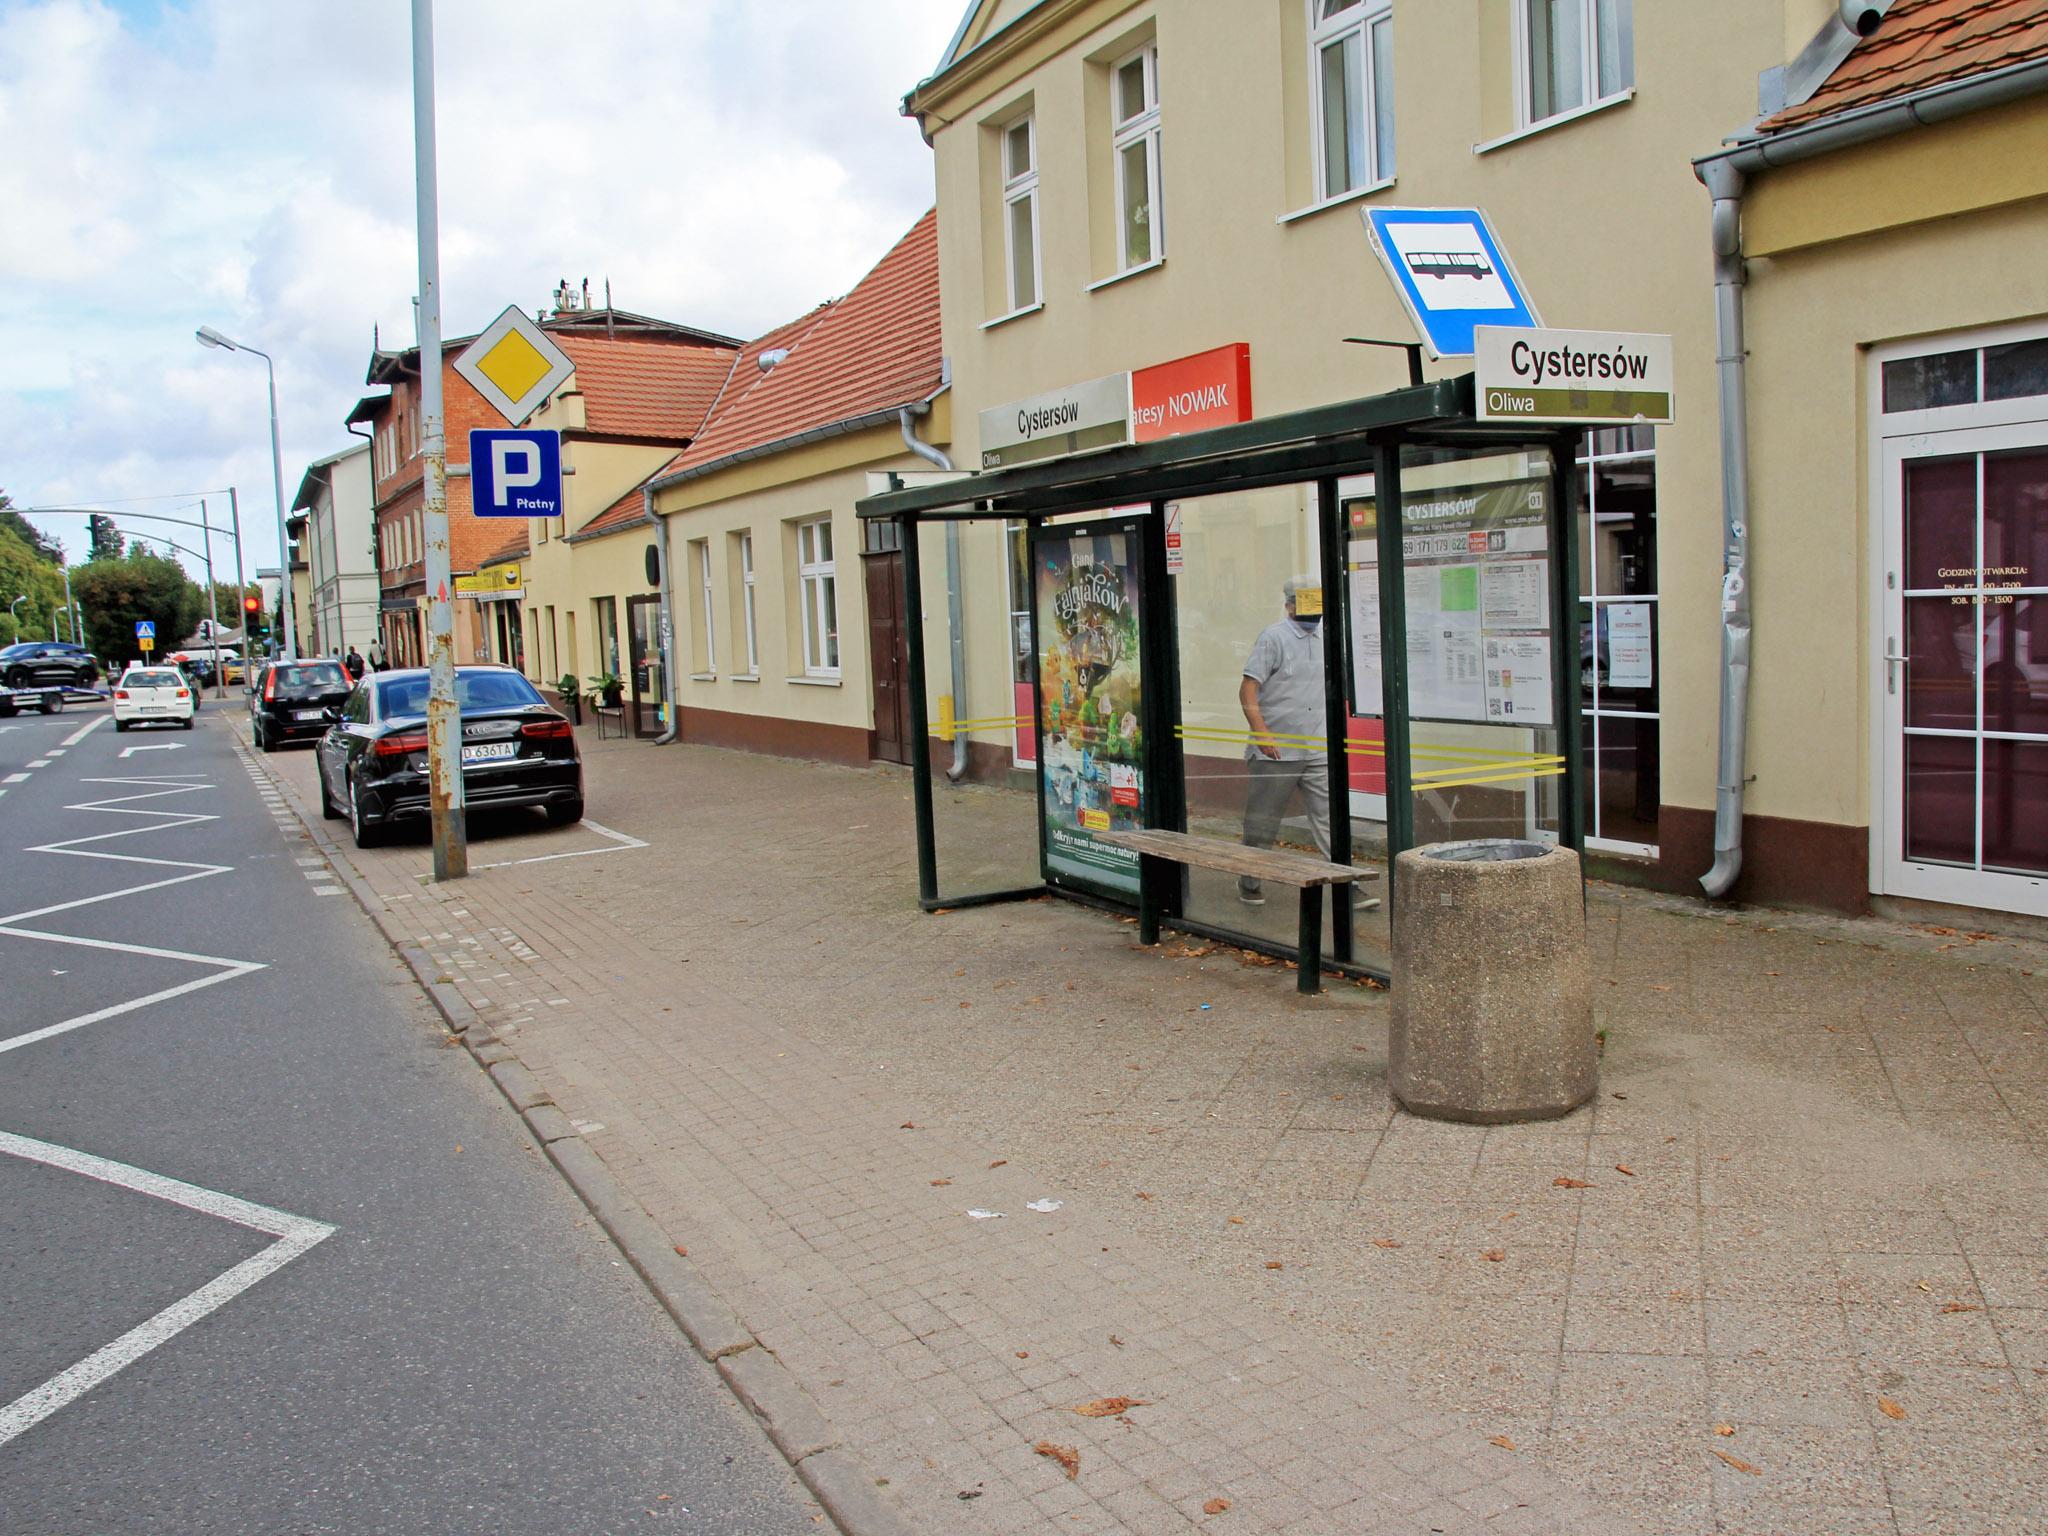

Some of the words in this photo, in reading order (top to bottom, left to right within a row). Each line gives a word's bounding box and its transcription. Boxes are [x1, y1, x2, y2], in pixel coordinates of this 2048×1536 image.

[1512, 341, 1648, 384] Cystersów
[1133, 402, 1165, 427] atesy
[1169, 383, 1228, 417] NOWAK
[1489, 392, 1535, 412] Oliwa
[1018, 399, 1078, 439] Cystersów
[491, 440, 541, 506] P
[517, 499, 555, 511] Płatny
[1408, 497, 1477, 520] CYSTERSÓW
[1530, 495, 1541, 506] 01
[1403, 542, 1414, 554] 69
[1417, 540, 1430, 553] 171
[1435, 539, 1448, 551] 179
[1972, 596, 1987, 604] 80
[1994, 596, 2013, 604] 15:00
[463, 747, 472, 759] D
[475, 744, 512, 757] 636TA
